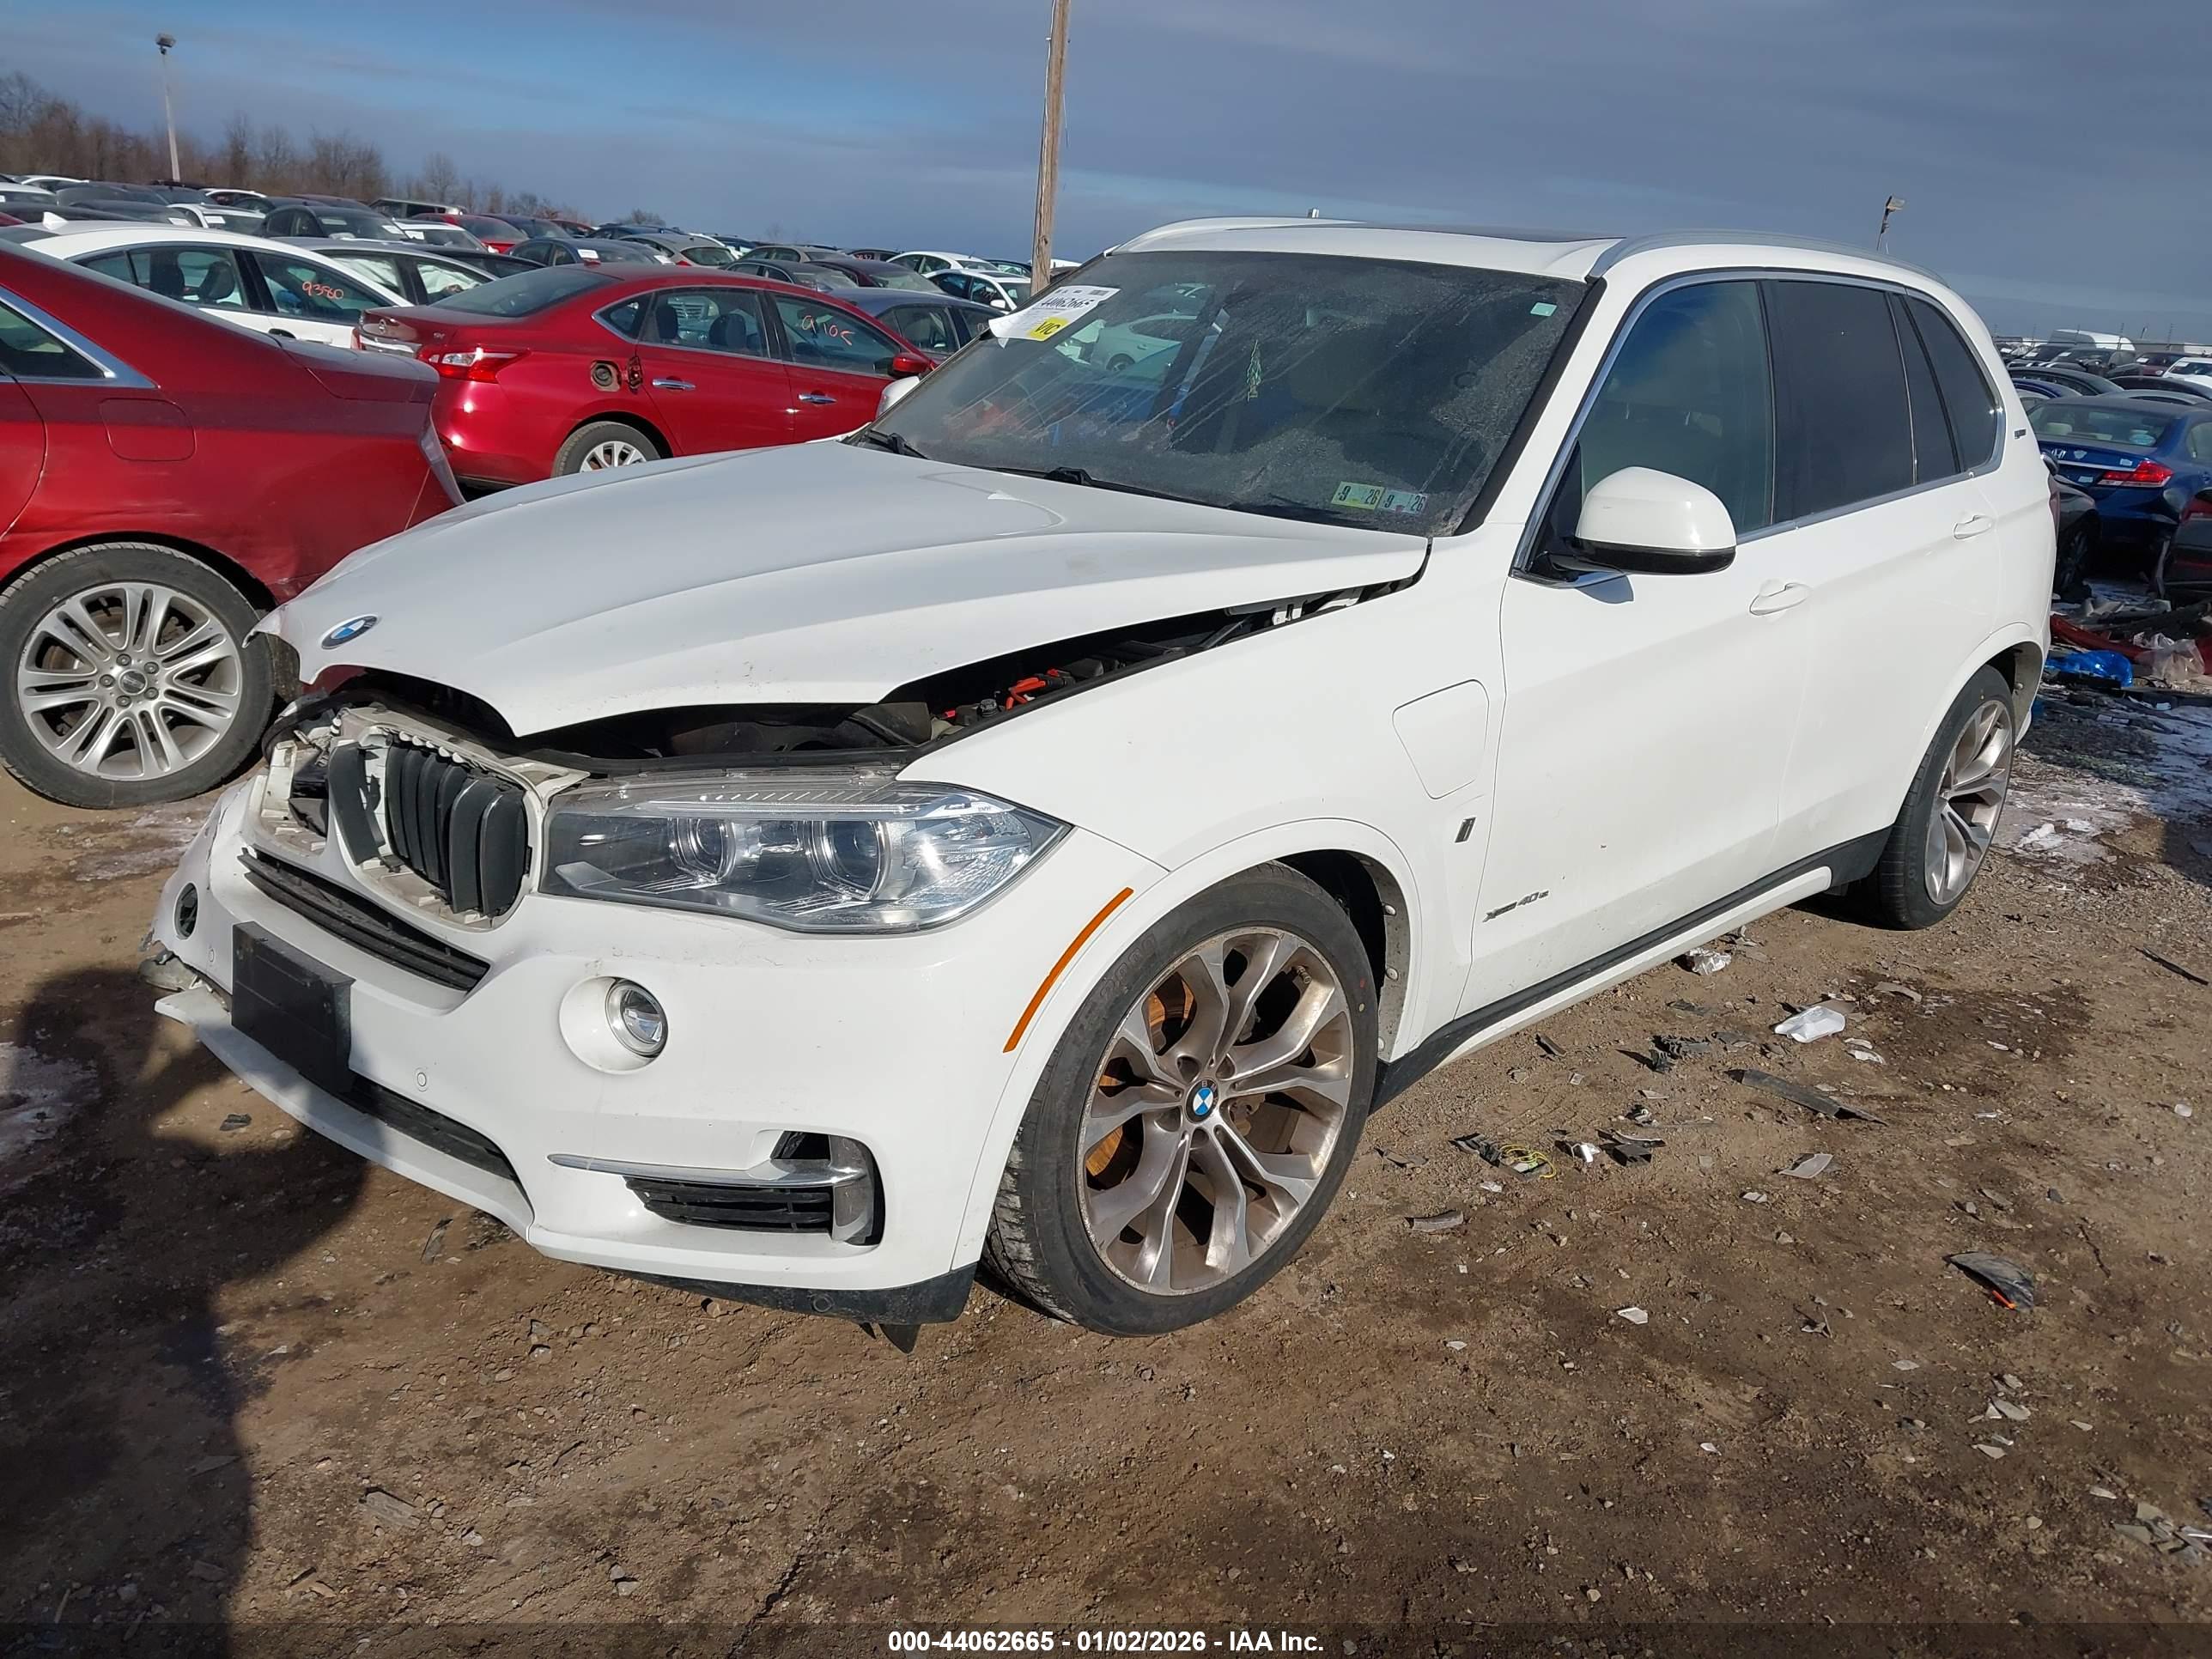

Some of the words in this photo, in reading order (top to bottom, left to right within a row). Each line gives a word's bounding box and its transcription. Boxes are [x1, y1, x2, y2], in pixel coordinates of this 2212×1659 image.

[1036, 322, 1060, 335] VIC
[1364, 489, 1380, 505] 26
[1411, 495, 1426, 512] 26
